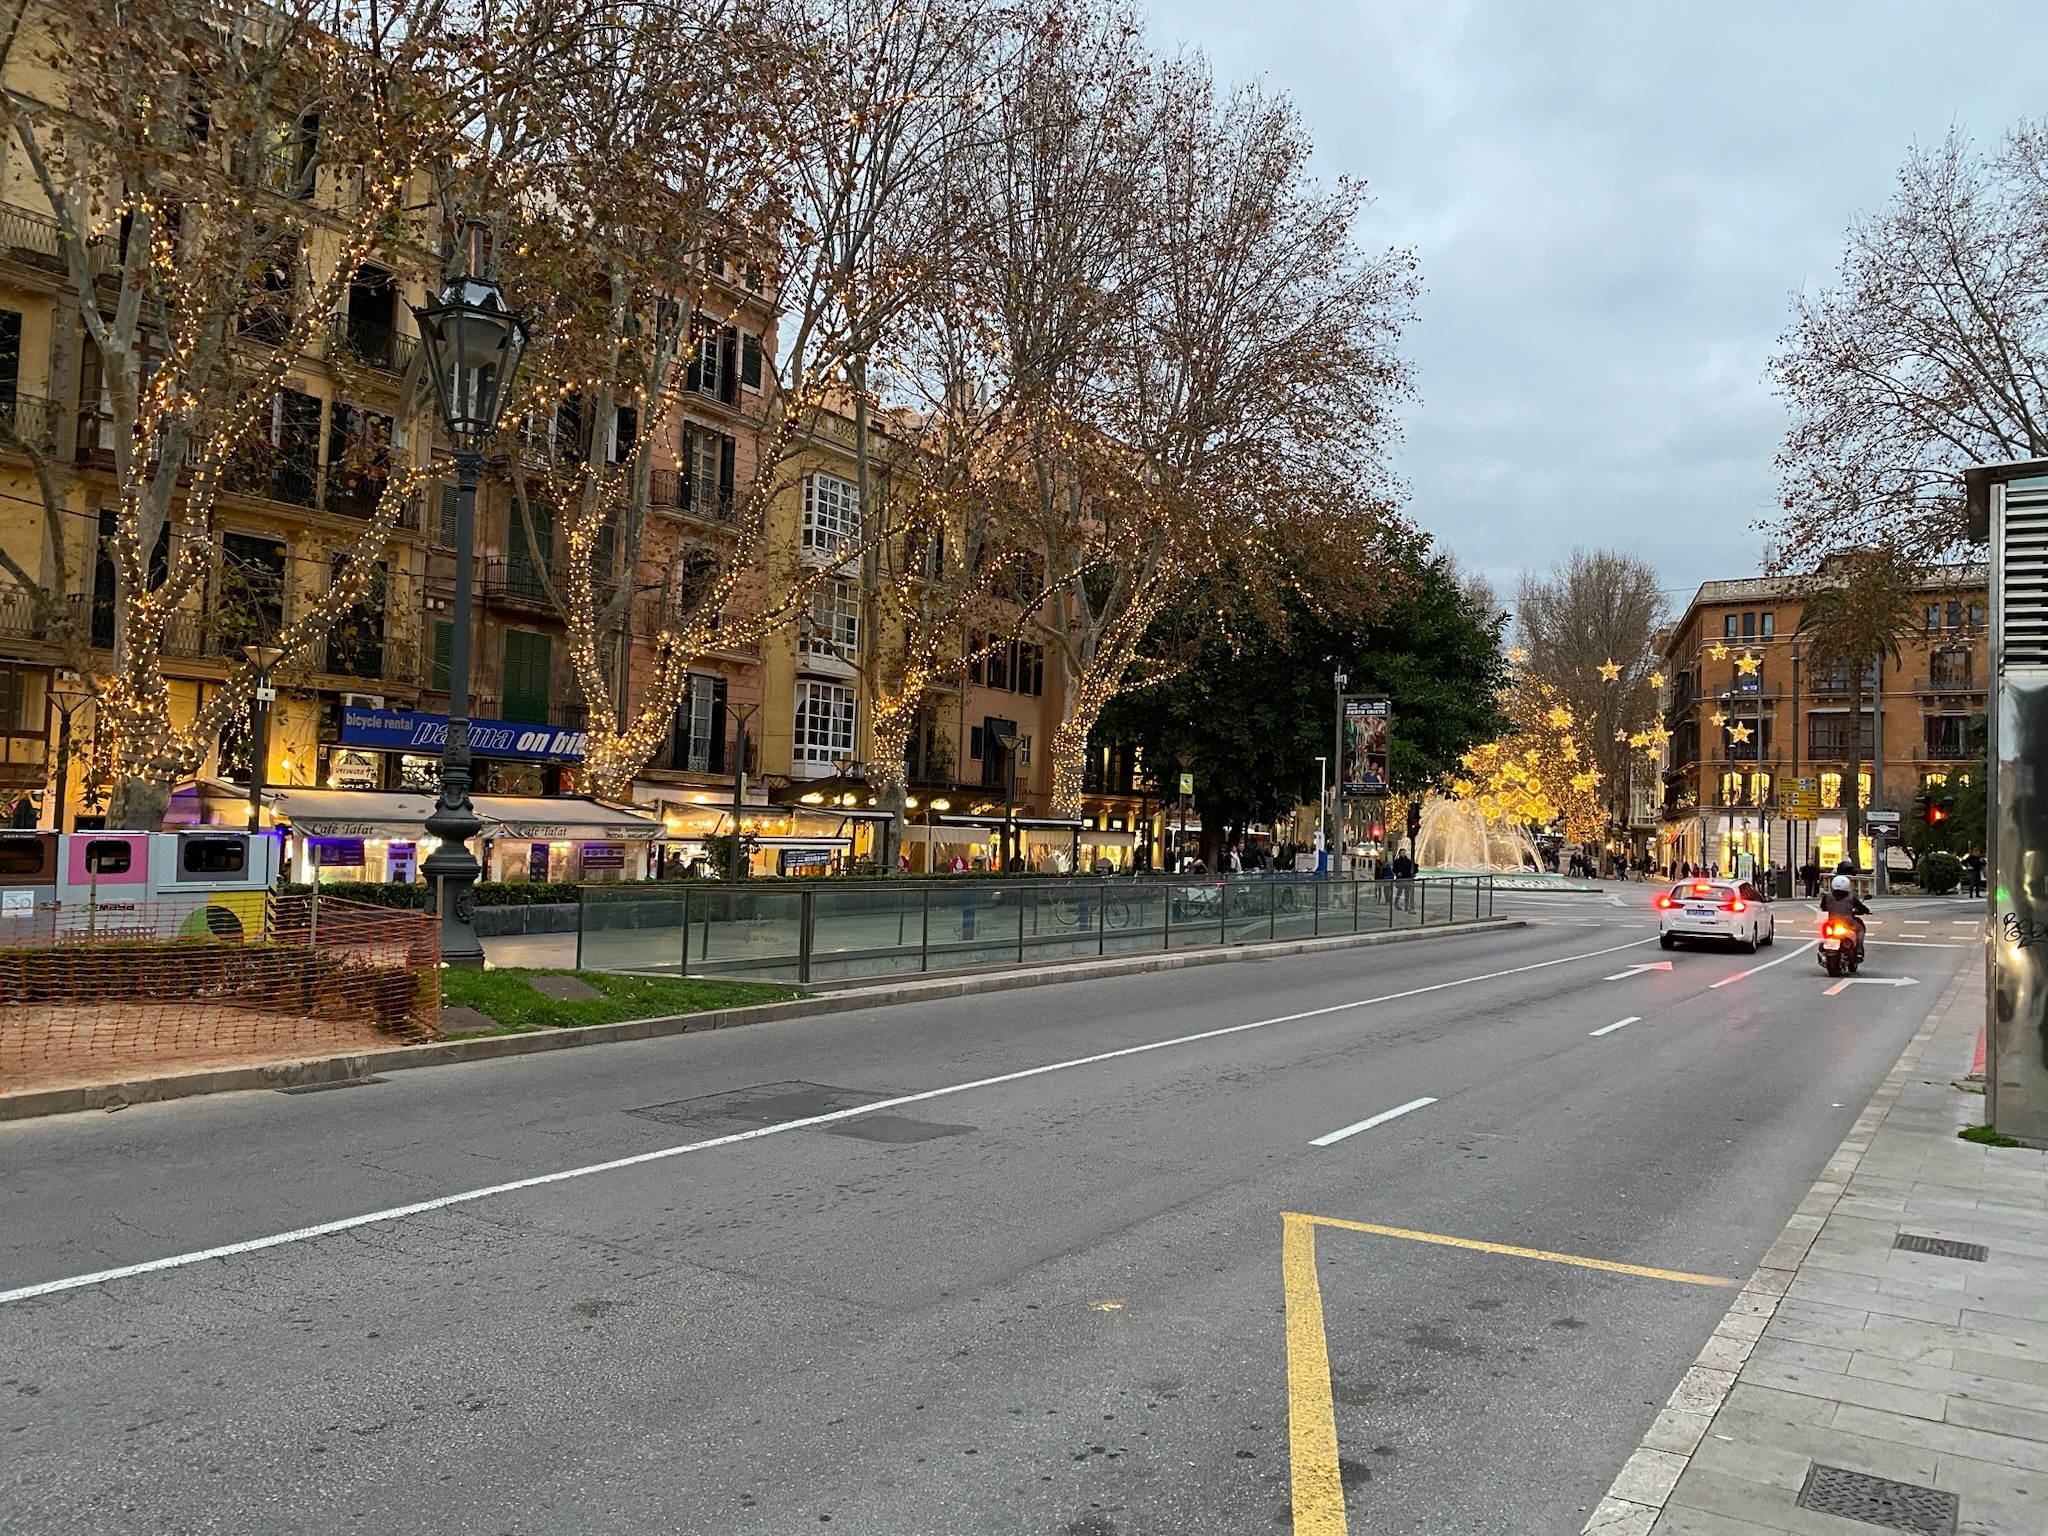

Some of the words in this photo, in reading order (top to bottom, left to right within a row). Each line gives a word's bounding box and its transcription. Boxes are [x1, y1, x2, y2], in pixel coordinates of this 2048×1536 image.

[345, 712, 382, 731] bicycle
[384, 717, 414, 731] rental
[411, 720, 515, 749] pama
[516, 731, 548, 752] on
[549, 731, 589, 755] bik
[312, 823, 338, 836] Café
[342, 823, 374, 835] Talat
[518, 825, 540, 837] Café
[541, 826, 567, 836] Talat
